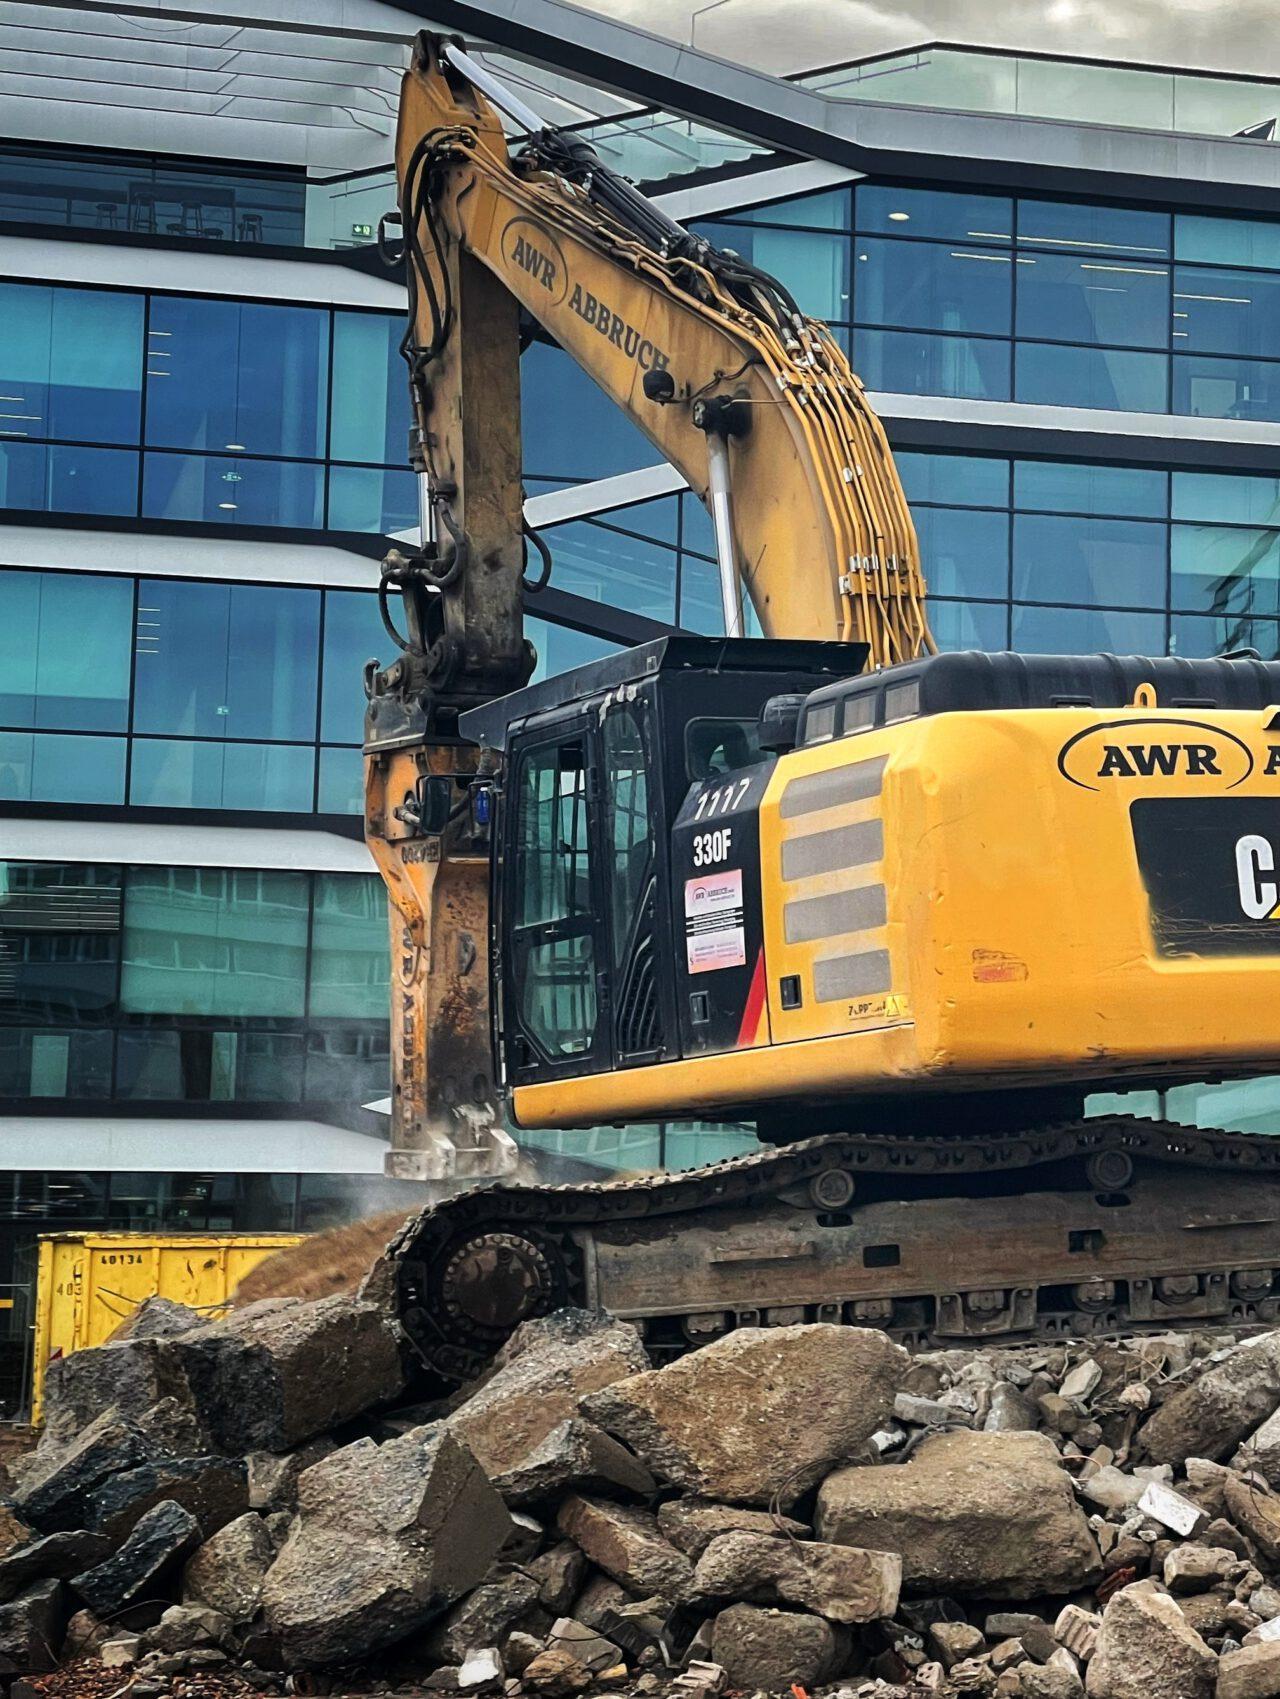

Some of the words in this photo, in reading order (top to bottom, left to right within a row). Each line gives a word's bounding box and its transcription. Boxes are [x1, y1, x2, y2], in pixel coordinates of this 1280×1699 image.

[511, 236, 556, 292] AWR
[568, 283, 670, 370] ABBRUCH
[1098, 744, 1222, 777] AWR
[694, 777, 750, 820] 1117
[693, 828, 732, 867] 330F
